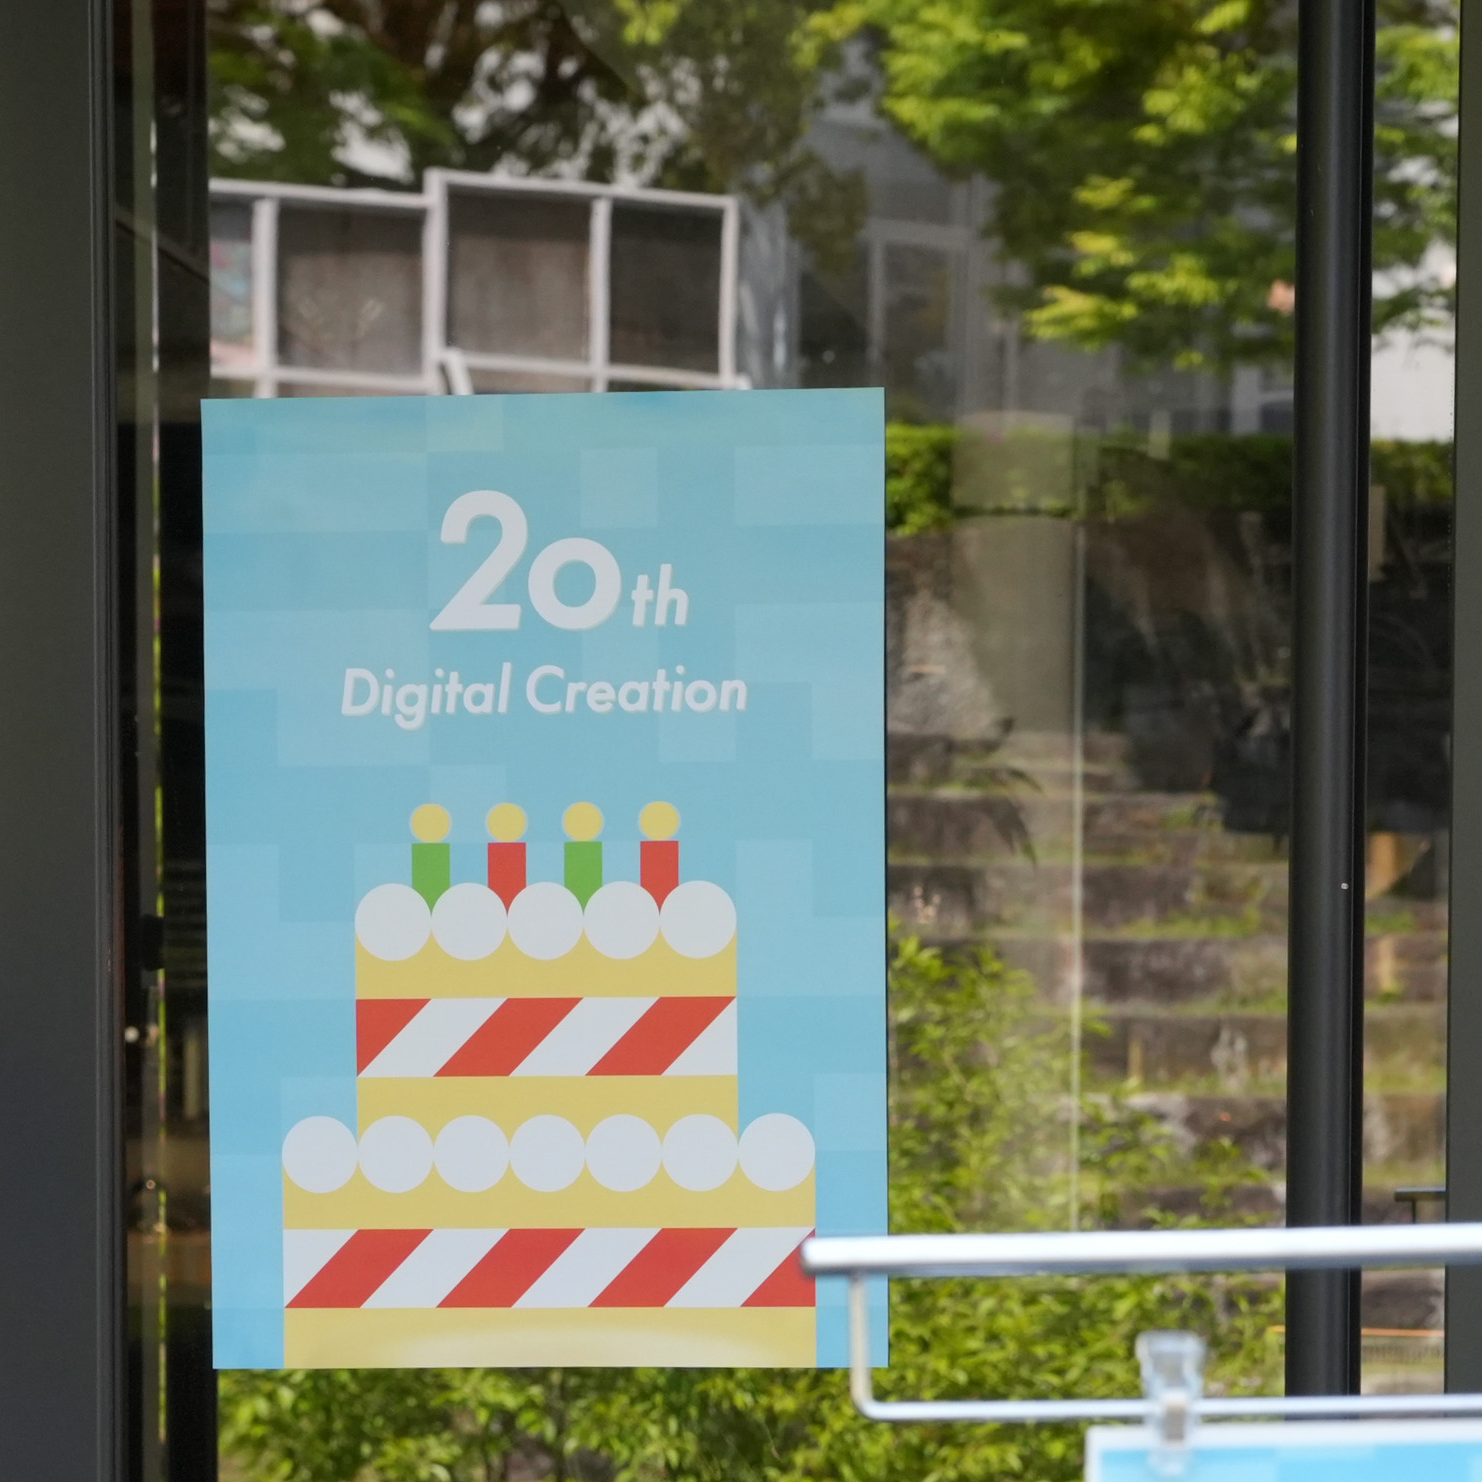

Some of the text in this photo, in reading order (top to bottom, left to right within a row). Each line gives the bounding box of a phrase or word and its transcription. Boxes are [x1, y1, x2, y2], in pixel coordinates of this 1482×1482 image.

[429, 489, 689, 631] 20th
[341, 661, 748, 730] Digital Creation
